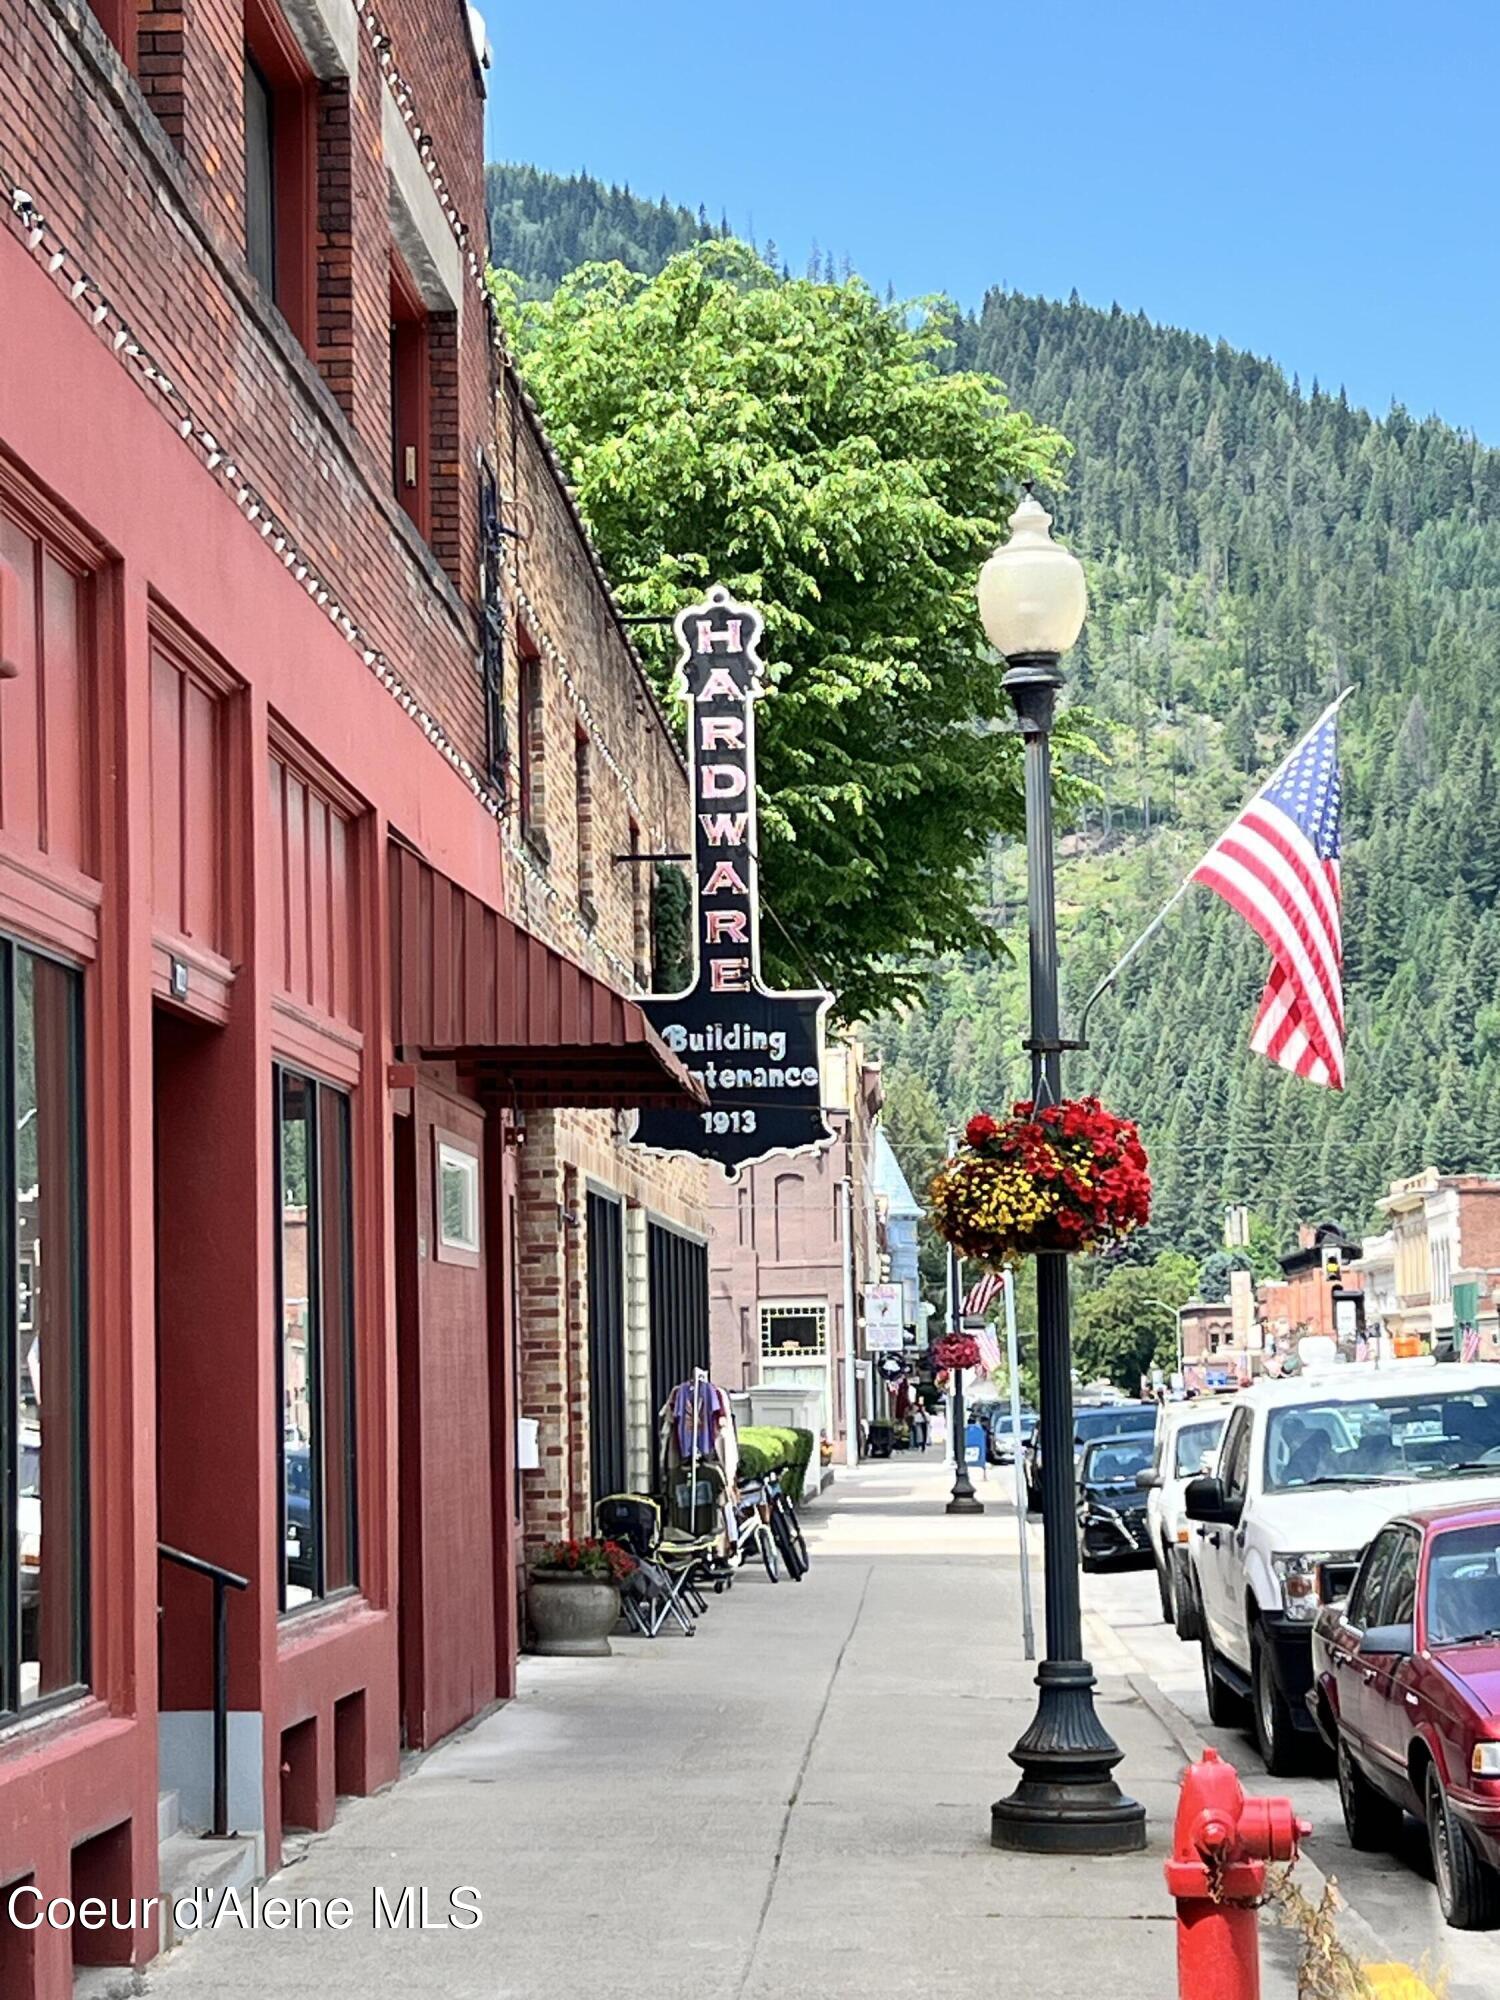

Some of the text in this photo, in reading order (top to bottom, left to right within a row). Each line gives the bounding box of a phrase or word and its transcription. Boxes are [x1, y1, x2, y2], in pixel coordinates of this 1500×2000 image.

[696, 619, 750, 992] HARDWARE
[662, 1023, 787, 1061] Building
[683, 1061, 819, 1089] ntenance
[701, 1110, 757, 1134] 1913
